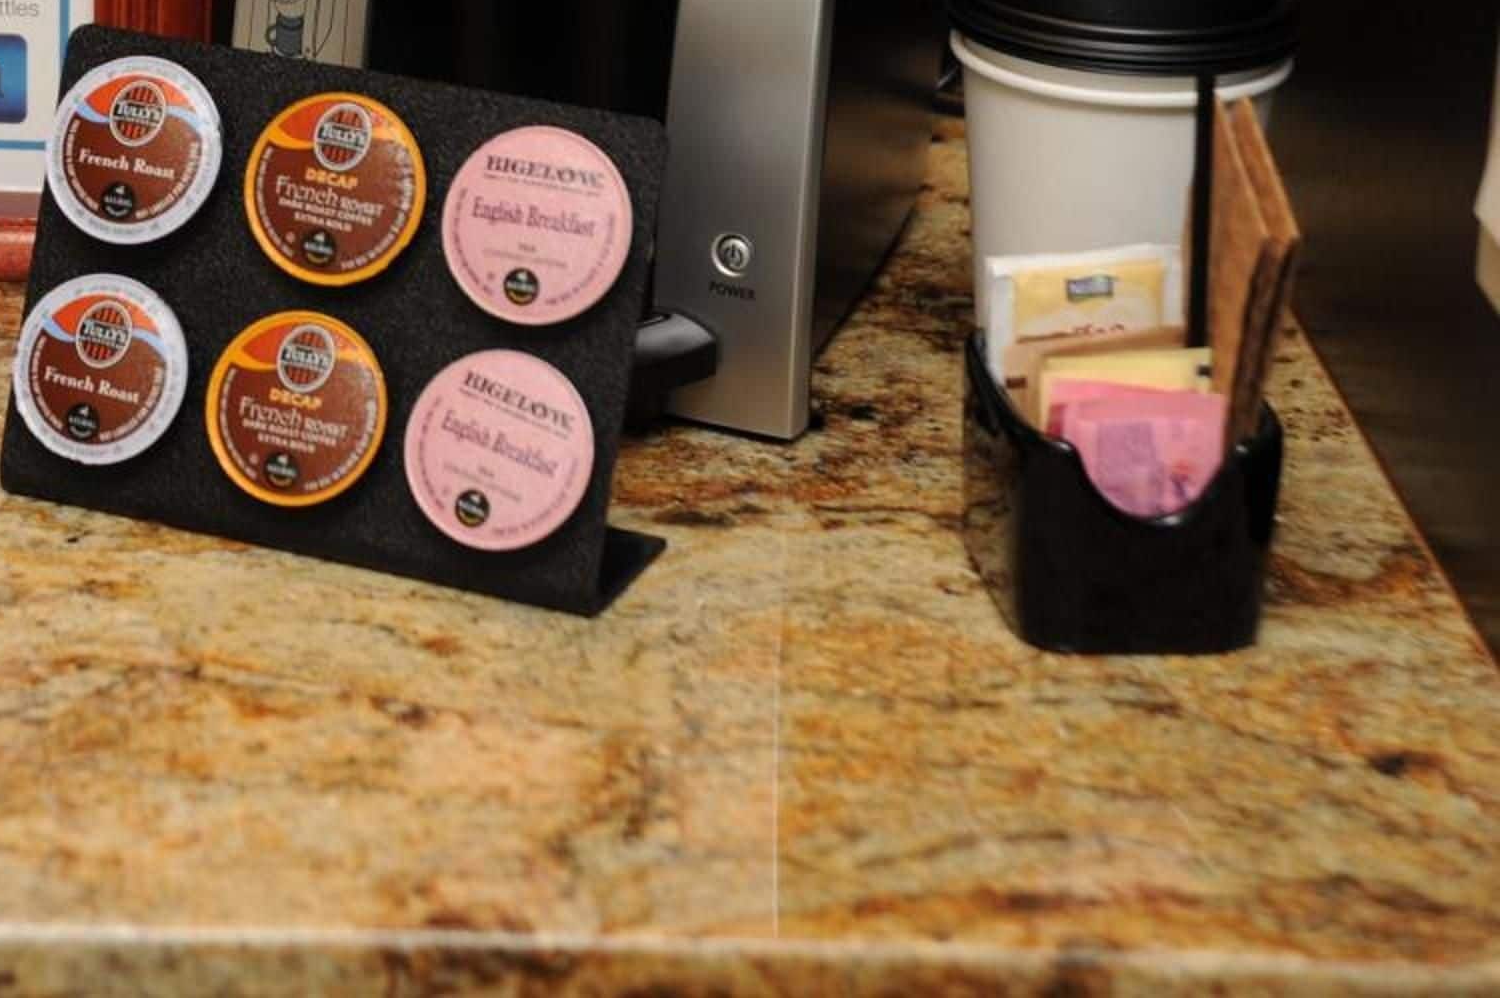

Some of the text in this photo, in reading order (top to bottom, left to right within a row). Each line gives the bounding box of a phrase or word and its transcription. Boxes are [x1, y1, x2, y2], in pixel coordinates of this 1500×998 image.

[78, 149, 176, 180] French Roast
[486, 155, 604, 188] BIGELOW
[275, 175, 337, 206] French
[471, 195, 596, 238] English Breakfast
[708, 280, 756, 300] POWER
[44, 365, 140, 404] French Roast
[464, 370, 575, 429] BIGELOW
[239, 395, 303, 427] French
[441, 409, 491, 447] English
[492, 430, 560, 478] Breakfast
